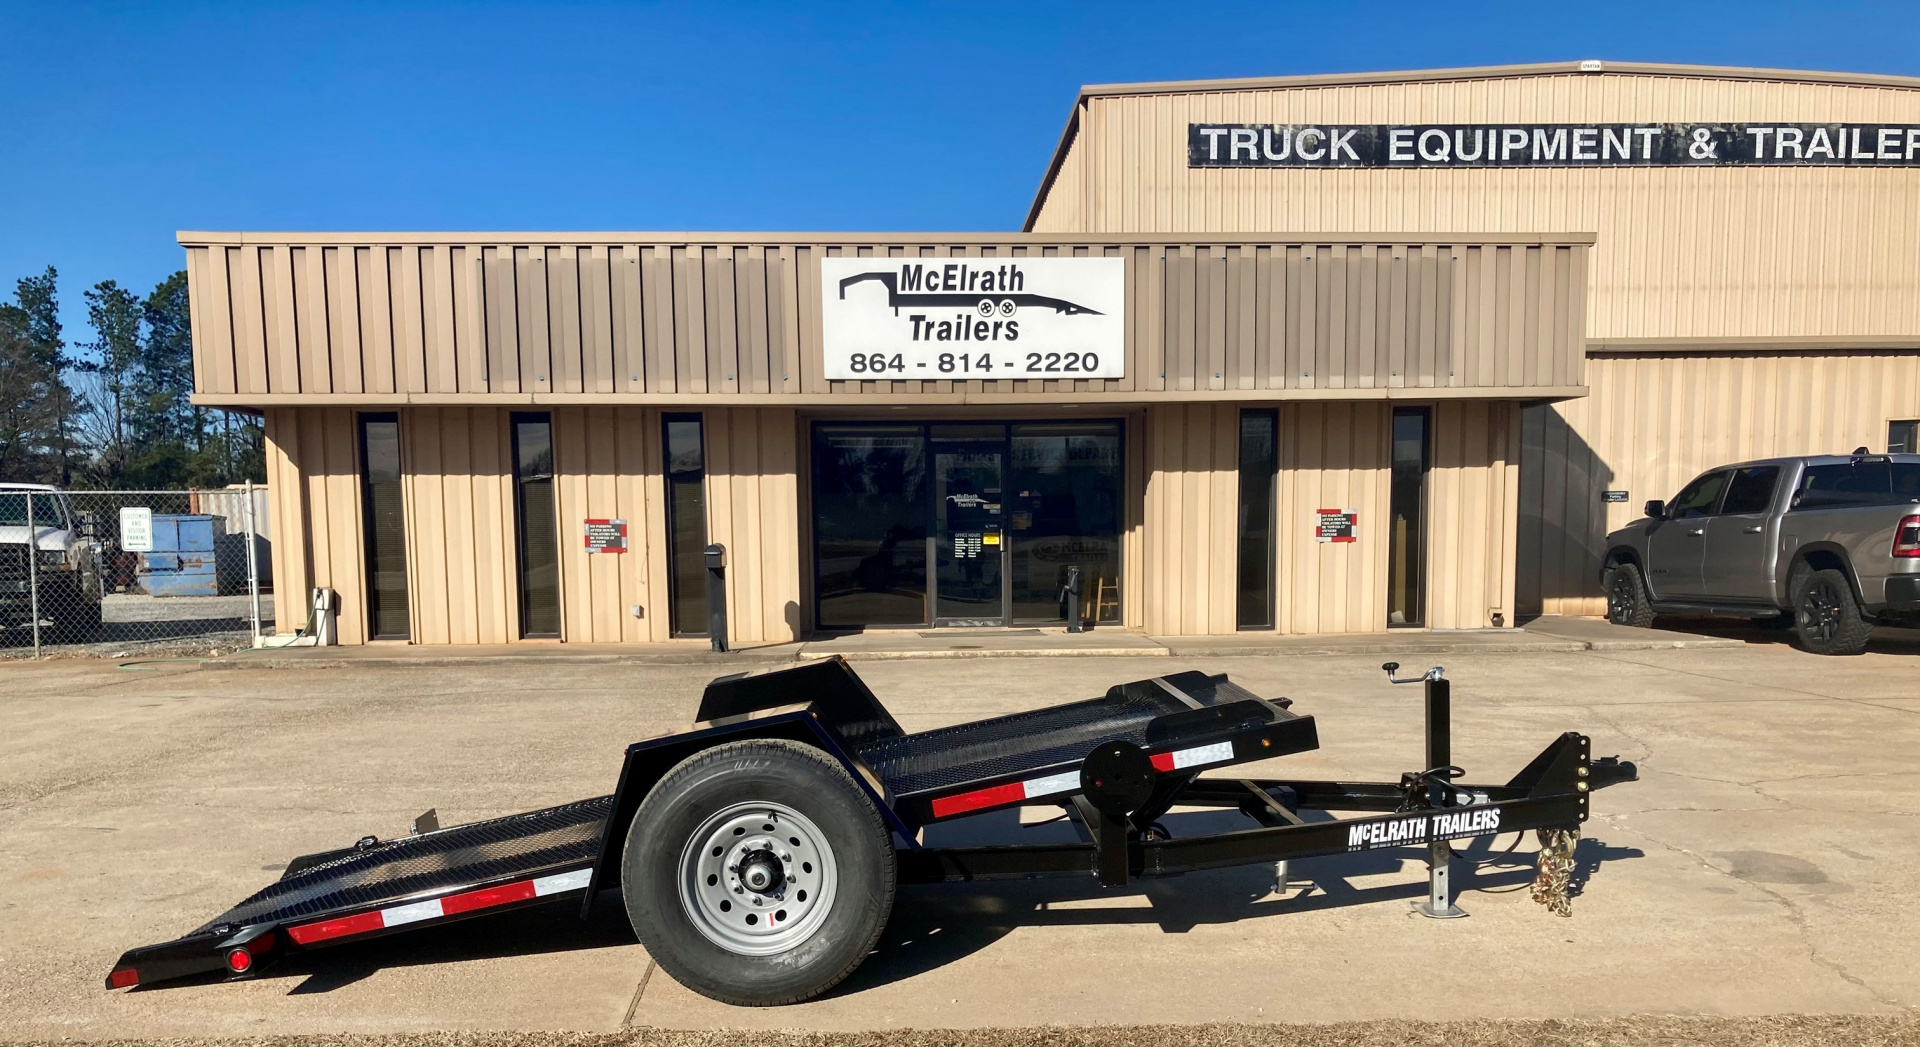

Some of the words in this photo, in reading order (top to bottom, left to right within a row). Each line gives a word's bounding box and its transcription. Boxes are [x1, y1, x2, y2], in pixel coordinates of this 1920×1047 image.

[1200, 128, 1360, 161] TRUCK
[1389, 128, 1662, 162] EQUIPMENT
[1688, 128, 1718, 160] &
[901, 264, 1025, 292] McElrath
[909, 314, 1020, 341] Trailers
[850, 353, 905, 373] 864
[938, 353, 993, 373] 814
[1026, 352, 1099, 373] 2220
[1432, 808, 1500, 836] TRAILERS
